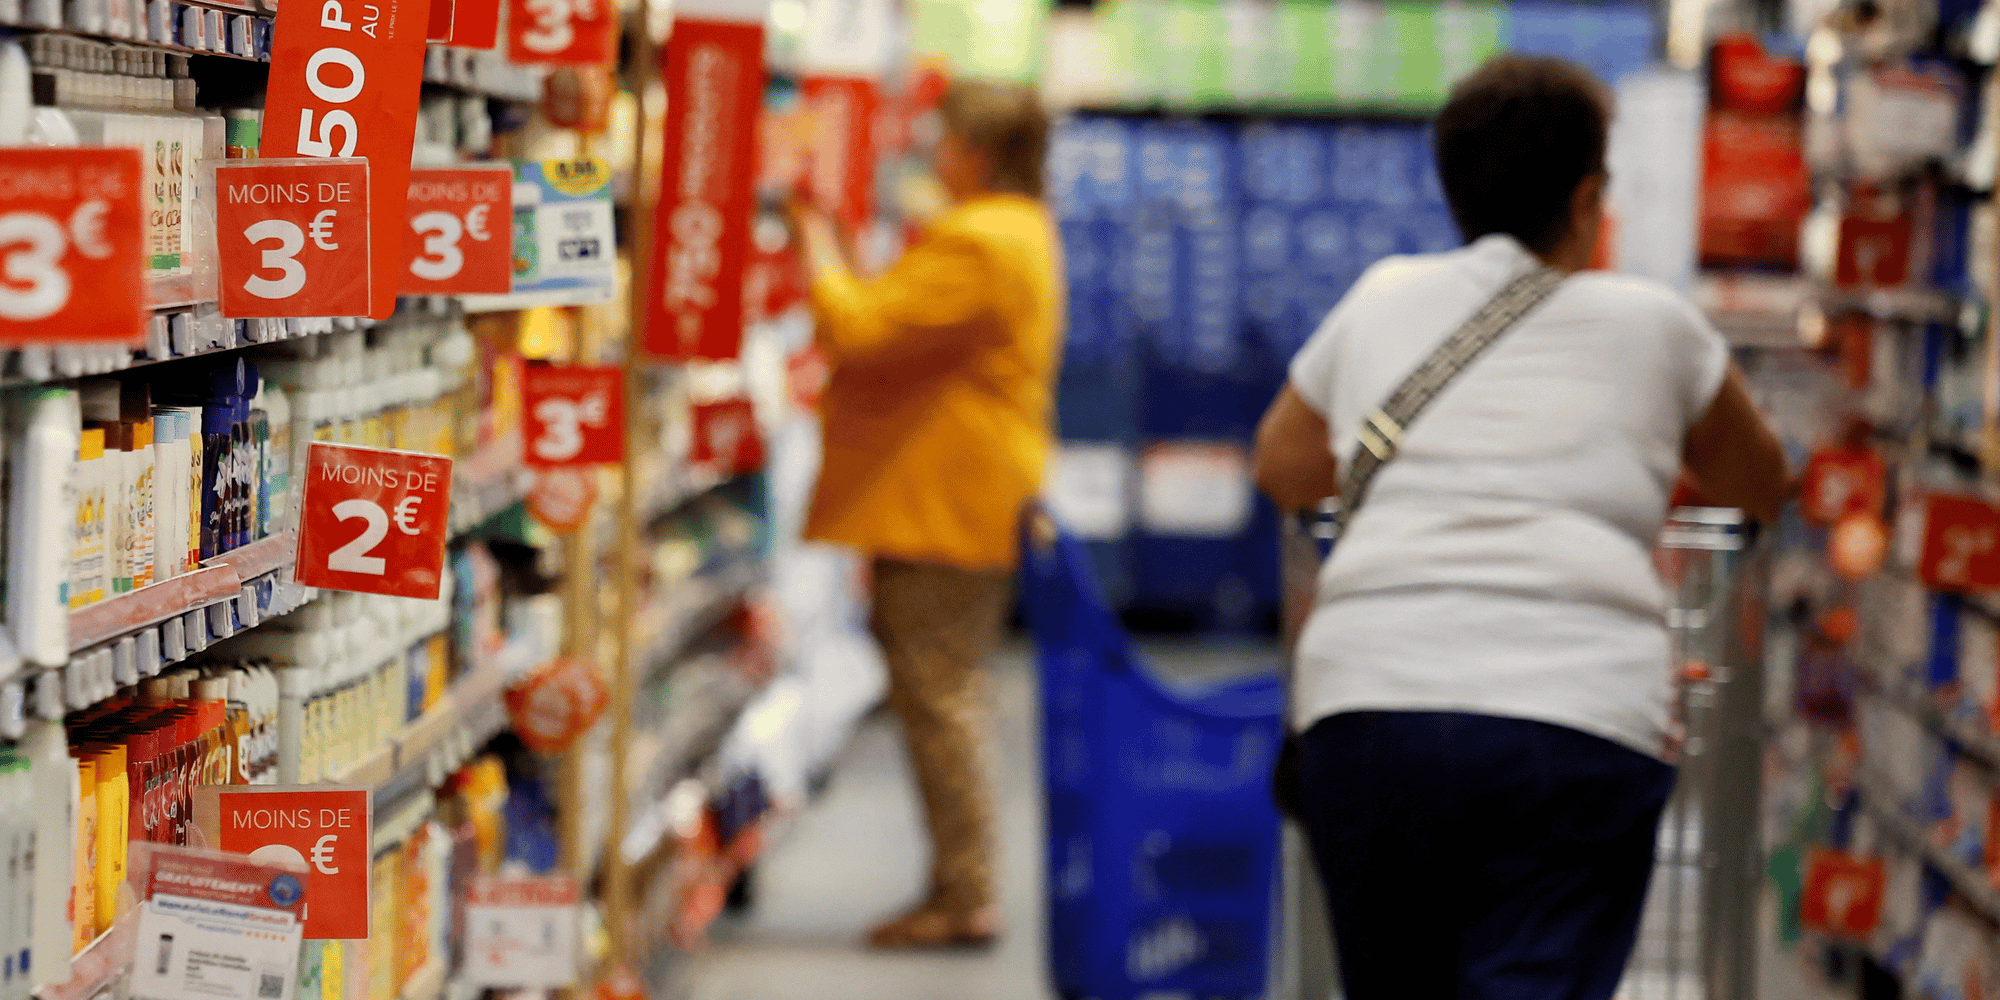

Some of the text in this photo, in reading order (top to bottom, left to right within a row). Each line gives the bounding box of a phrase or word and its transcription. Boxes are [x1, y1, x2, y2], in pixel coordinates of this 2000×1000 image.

[229, 182, 350, 204] MOINS DE
[243, 209, 339, 299] 3€
[409, 203, 492, 281] 3€
[322, 463, 437, 492] MOINS DE
[328, 496, 422, 575] 2€
[233, 809, 350, 829] MOINS DE
